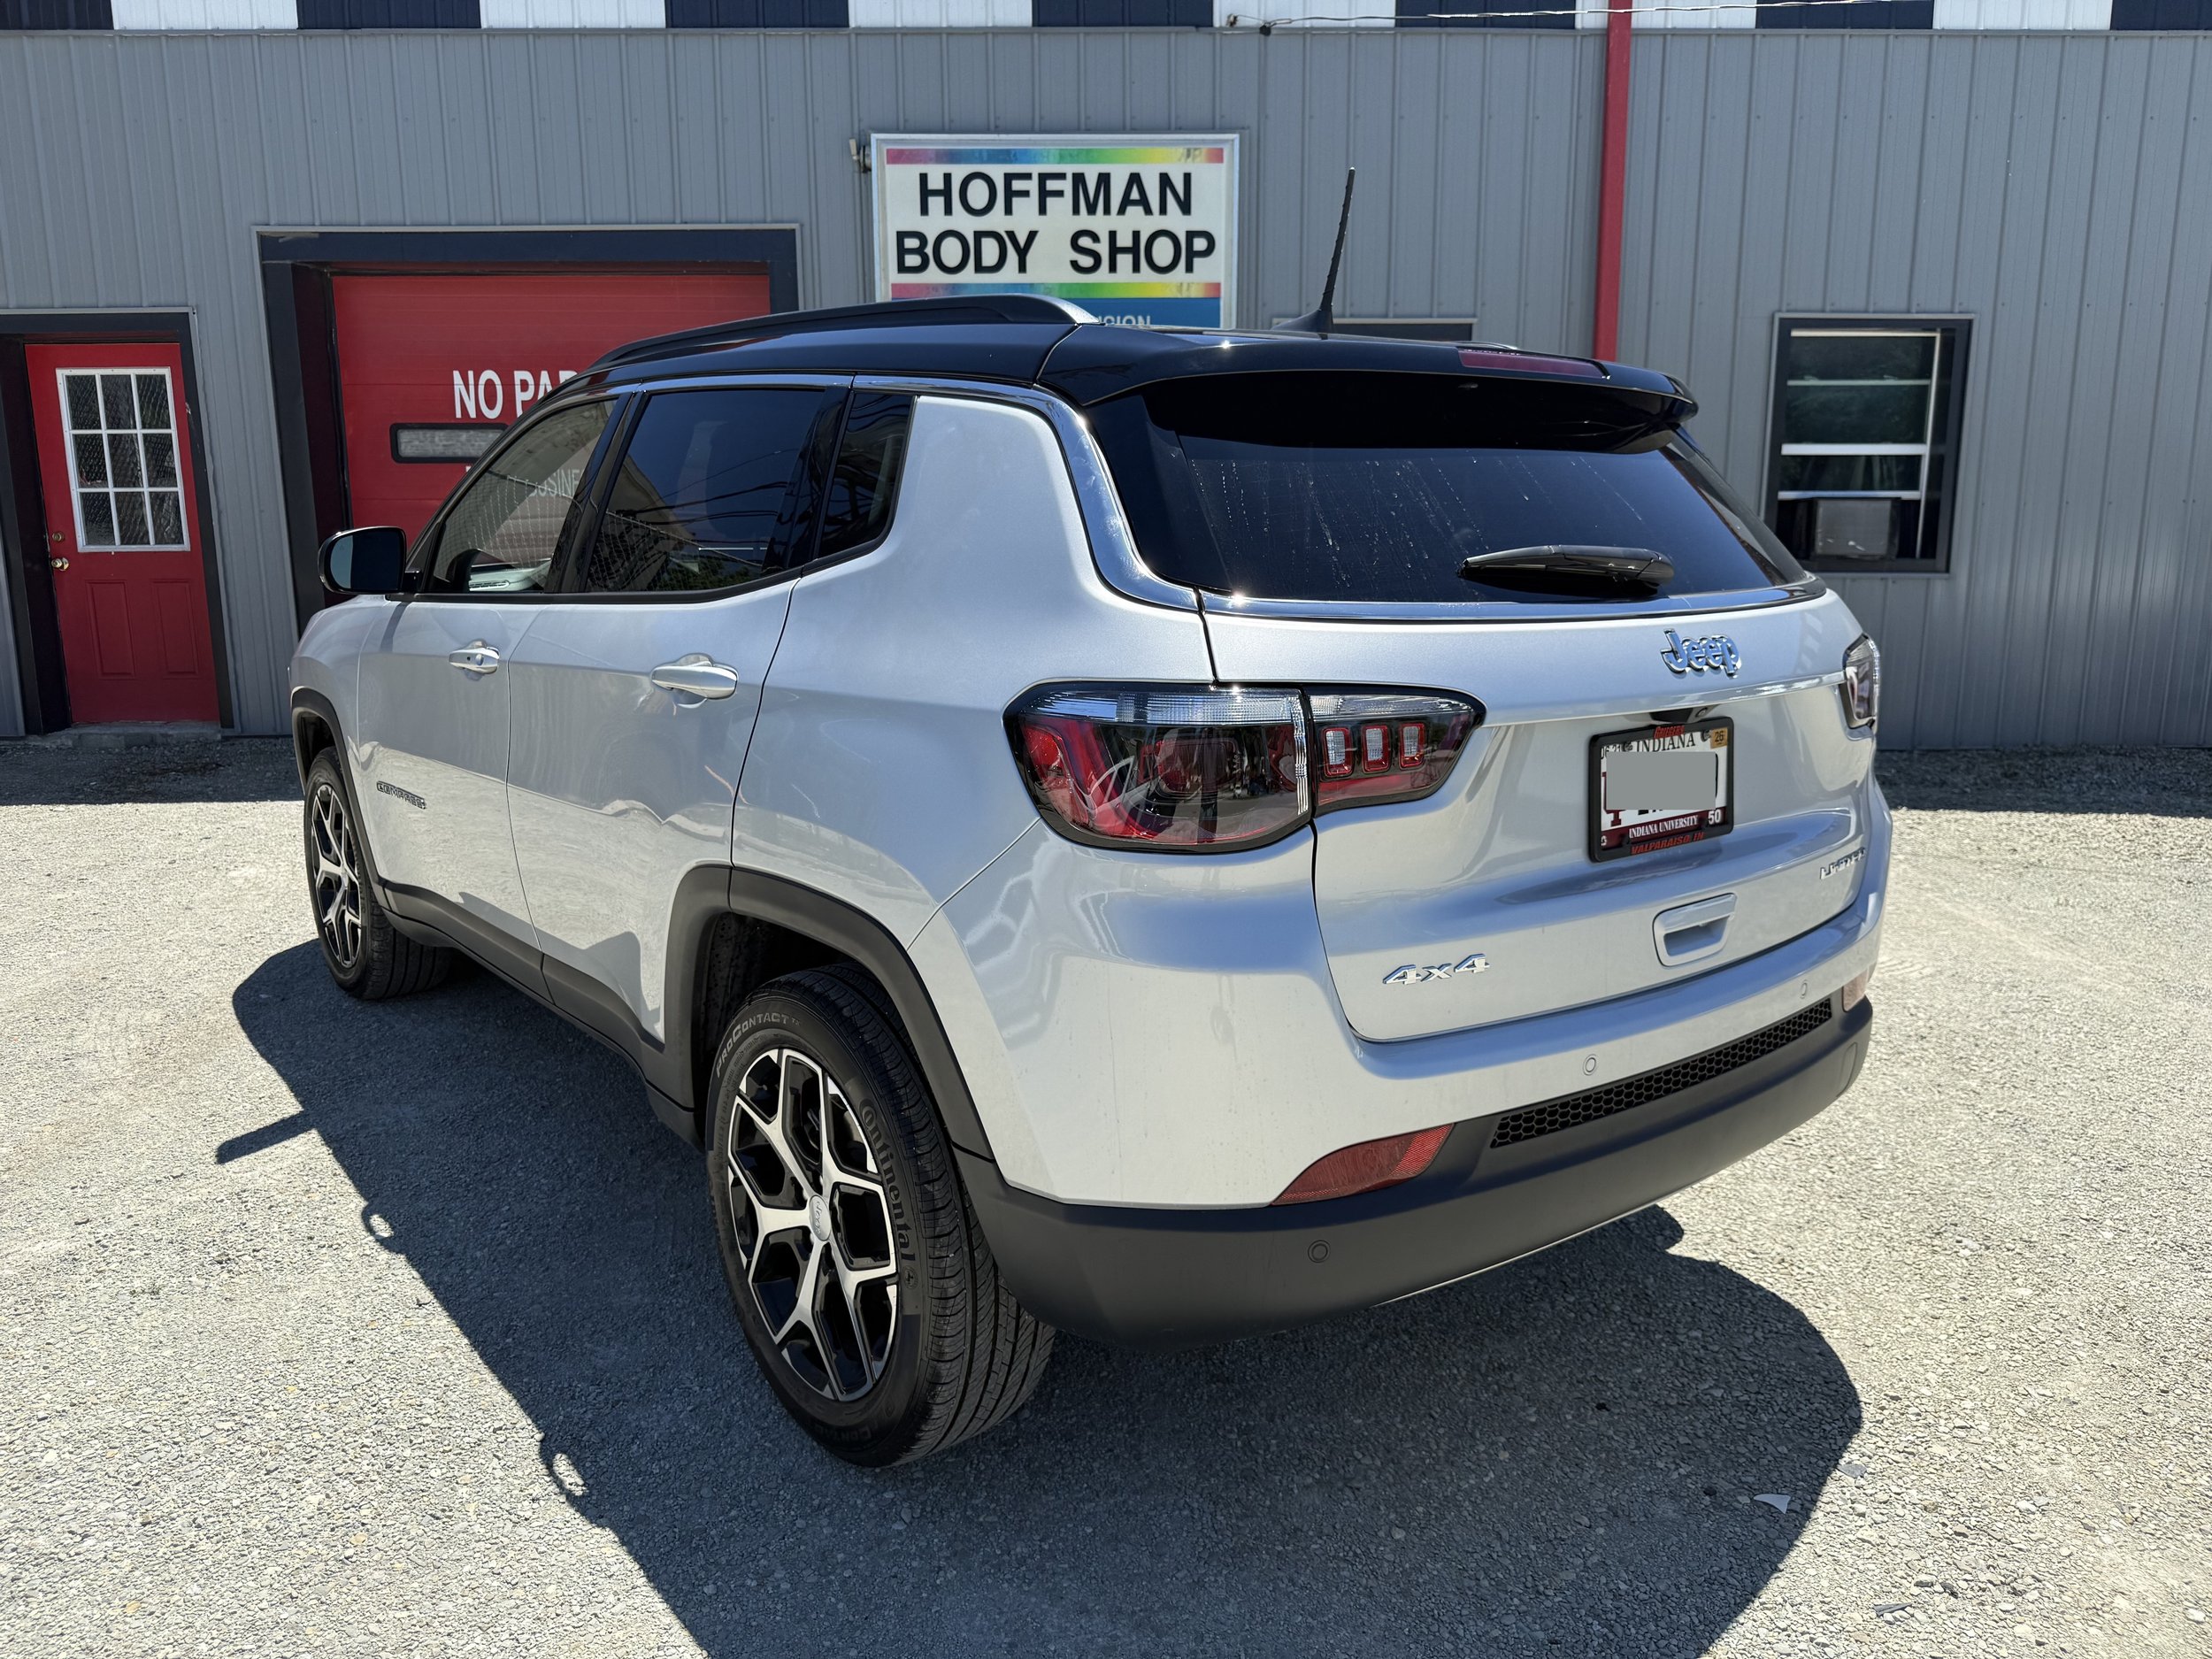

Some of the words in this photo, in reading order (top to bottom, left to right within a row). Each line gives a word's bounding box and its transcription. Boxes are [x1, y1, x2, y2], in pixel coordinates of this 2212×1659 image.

[918, 172, 1193, 218] HOFFMAN
[895, 229, 1039, 275] BODY
[1069, 229, 1217, 275] SHOP
[453, 370, 503, 419] NO
[1661, 628, 1741, 679] Jeep
[1637, 733, 1696, 752] INDIANA
[1715, 731, 1724, 742] 26
[376, 780, 426, 810] COMPASS
[1629, 824, 1658, 839] INDIANA
[1659, 815, 1699, 833] UNIVERSITY
[1708, 809, 1722, 825] 50
[1693, 832, 1704, 841] IN
[857, 1097, 917, 1263] Continental
